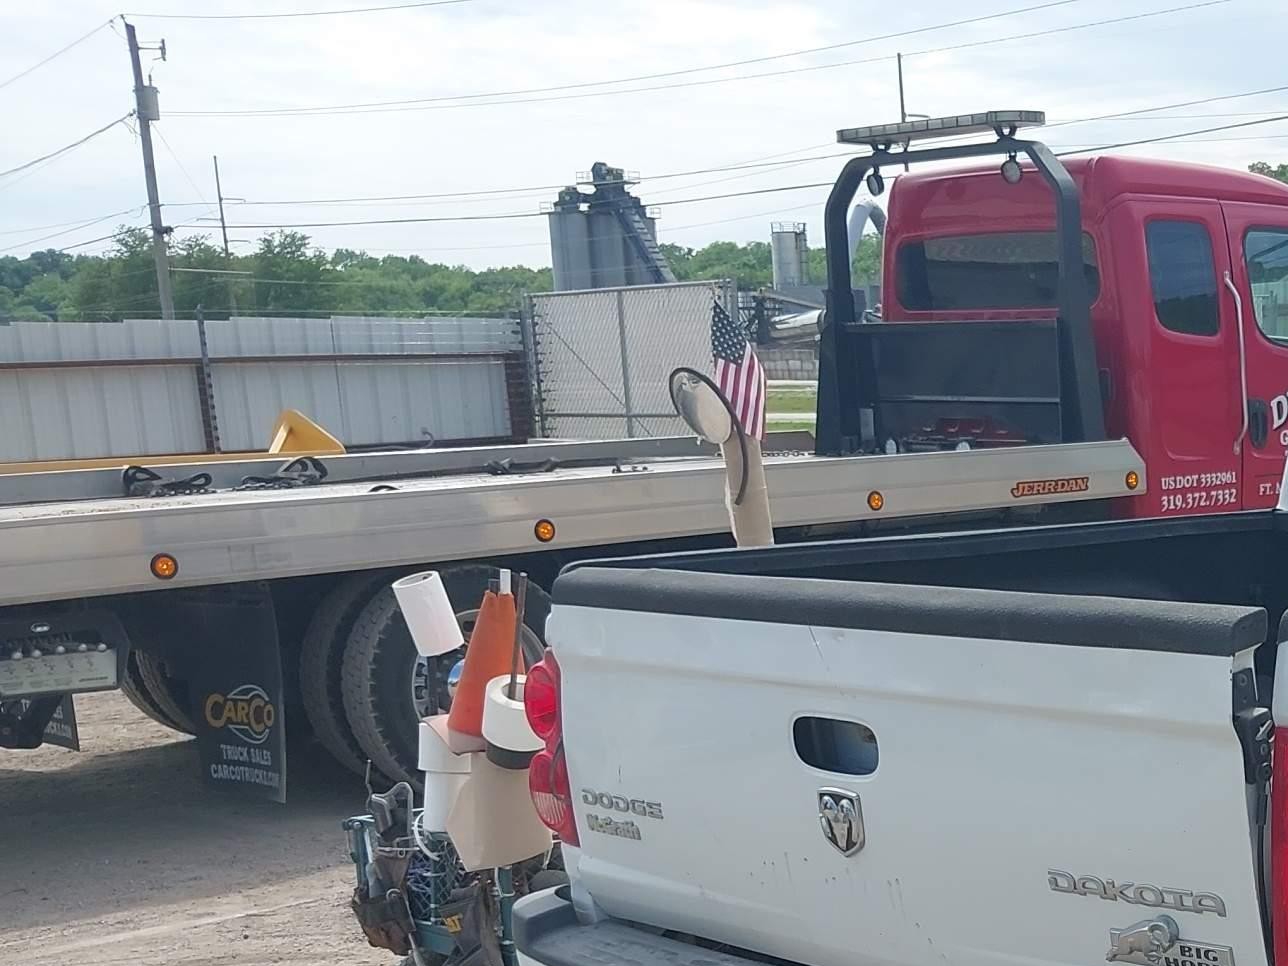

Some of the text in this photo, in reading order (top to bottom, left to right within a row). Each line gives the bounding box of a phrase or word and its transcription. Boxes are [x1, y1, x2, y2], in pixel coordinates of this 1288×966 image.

[1200, 471, 1237, 487] 3332961
[1259, 483, 1274, 496] FT.
[1160, 488, 1237, 512] 319.372.7332
[220, 744, 272, 766] TRUCK SALES
[582, 787, 665, 820] DODGE
[1047, 868, 1227, 918] DAKOTA
[1179, 945, 1219, 962] BIG
